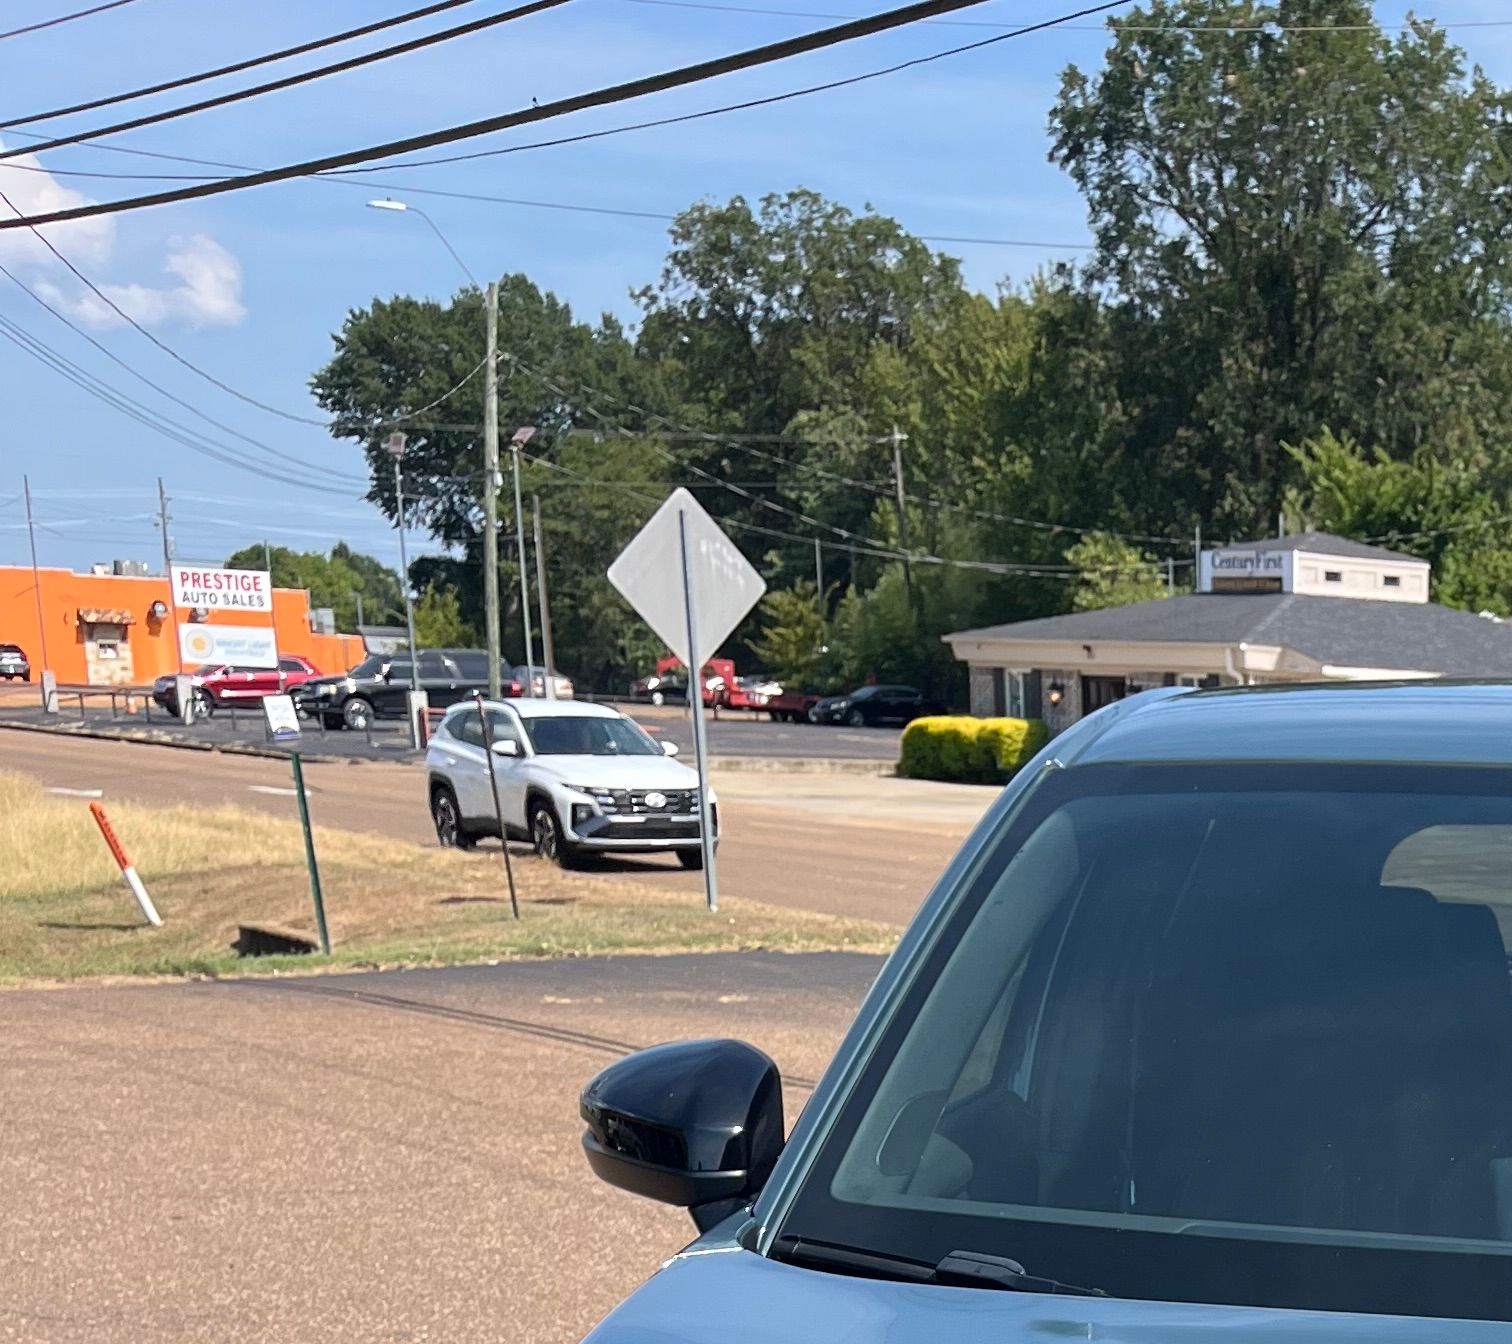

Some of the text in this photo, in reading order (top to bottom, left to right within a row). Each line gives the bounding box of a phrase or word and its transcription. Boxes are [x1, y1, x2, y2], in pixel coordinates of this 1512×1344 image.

[180, 571, 262, 592] PRESTIGE
[182, 592, 265, 608] AUTO SALES
